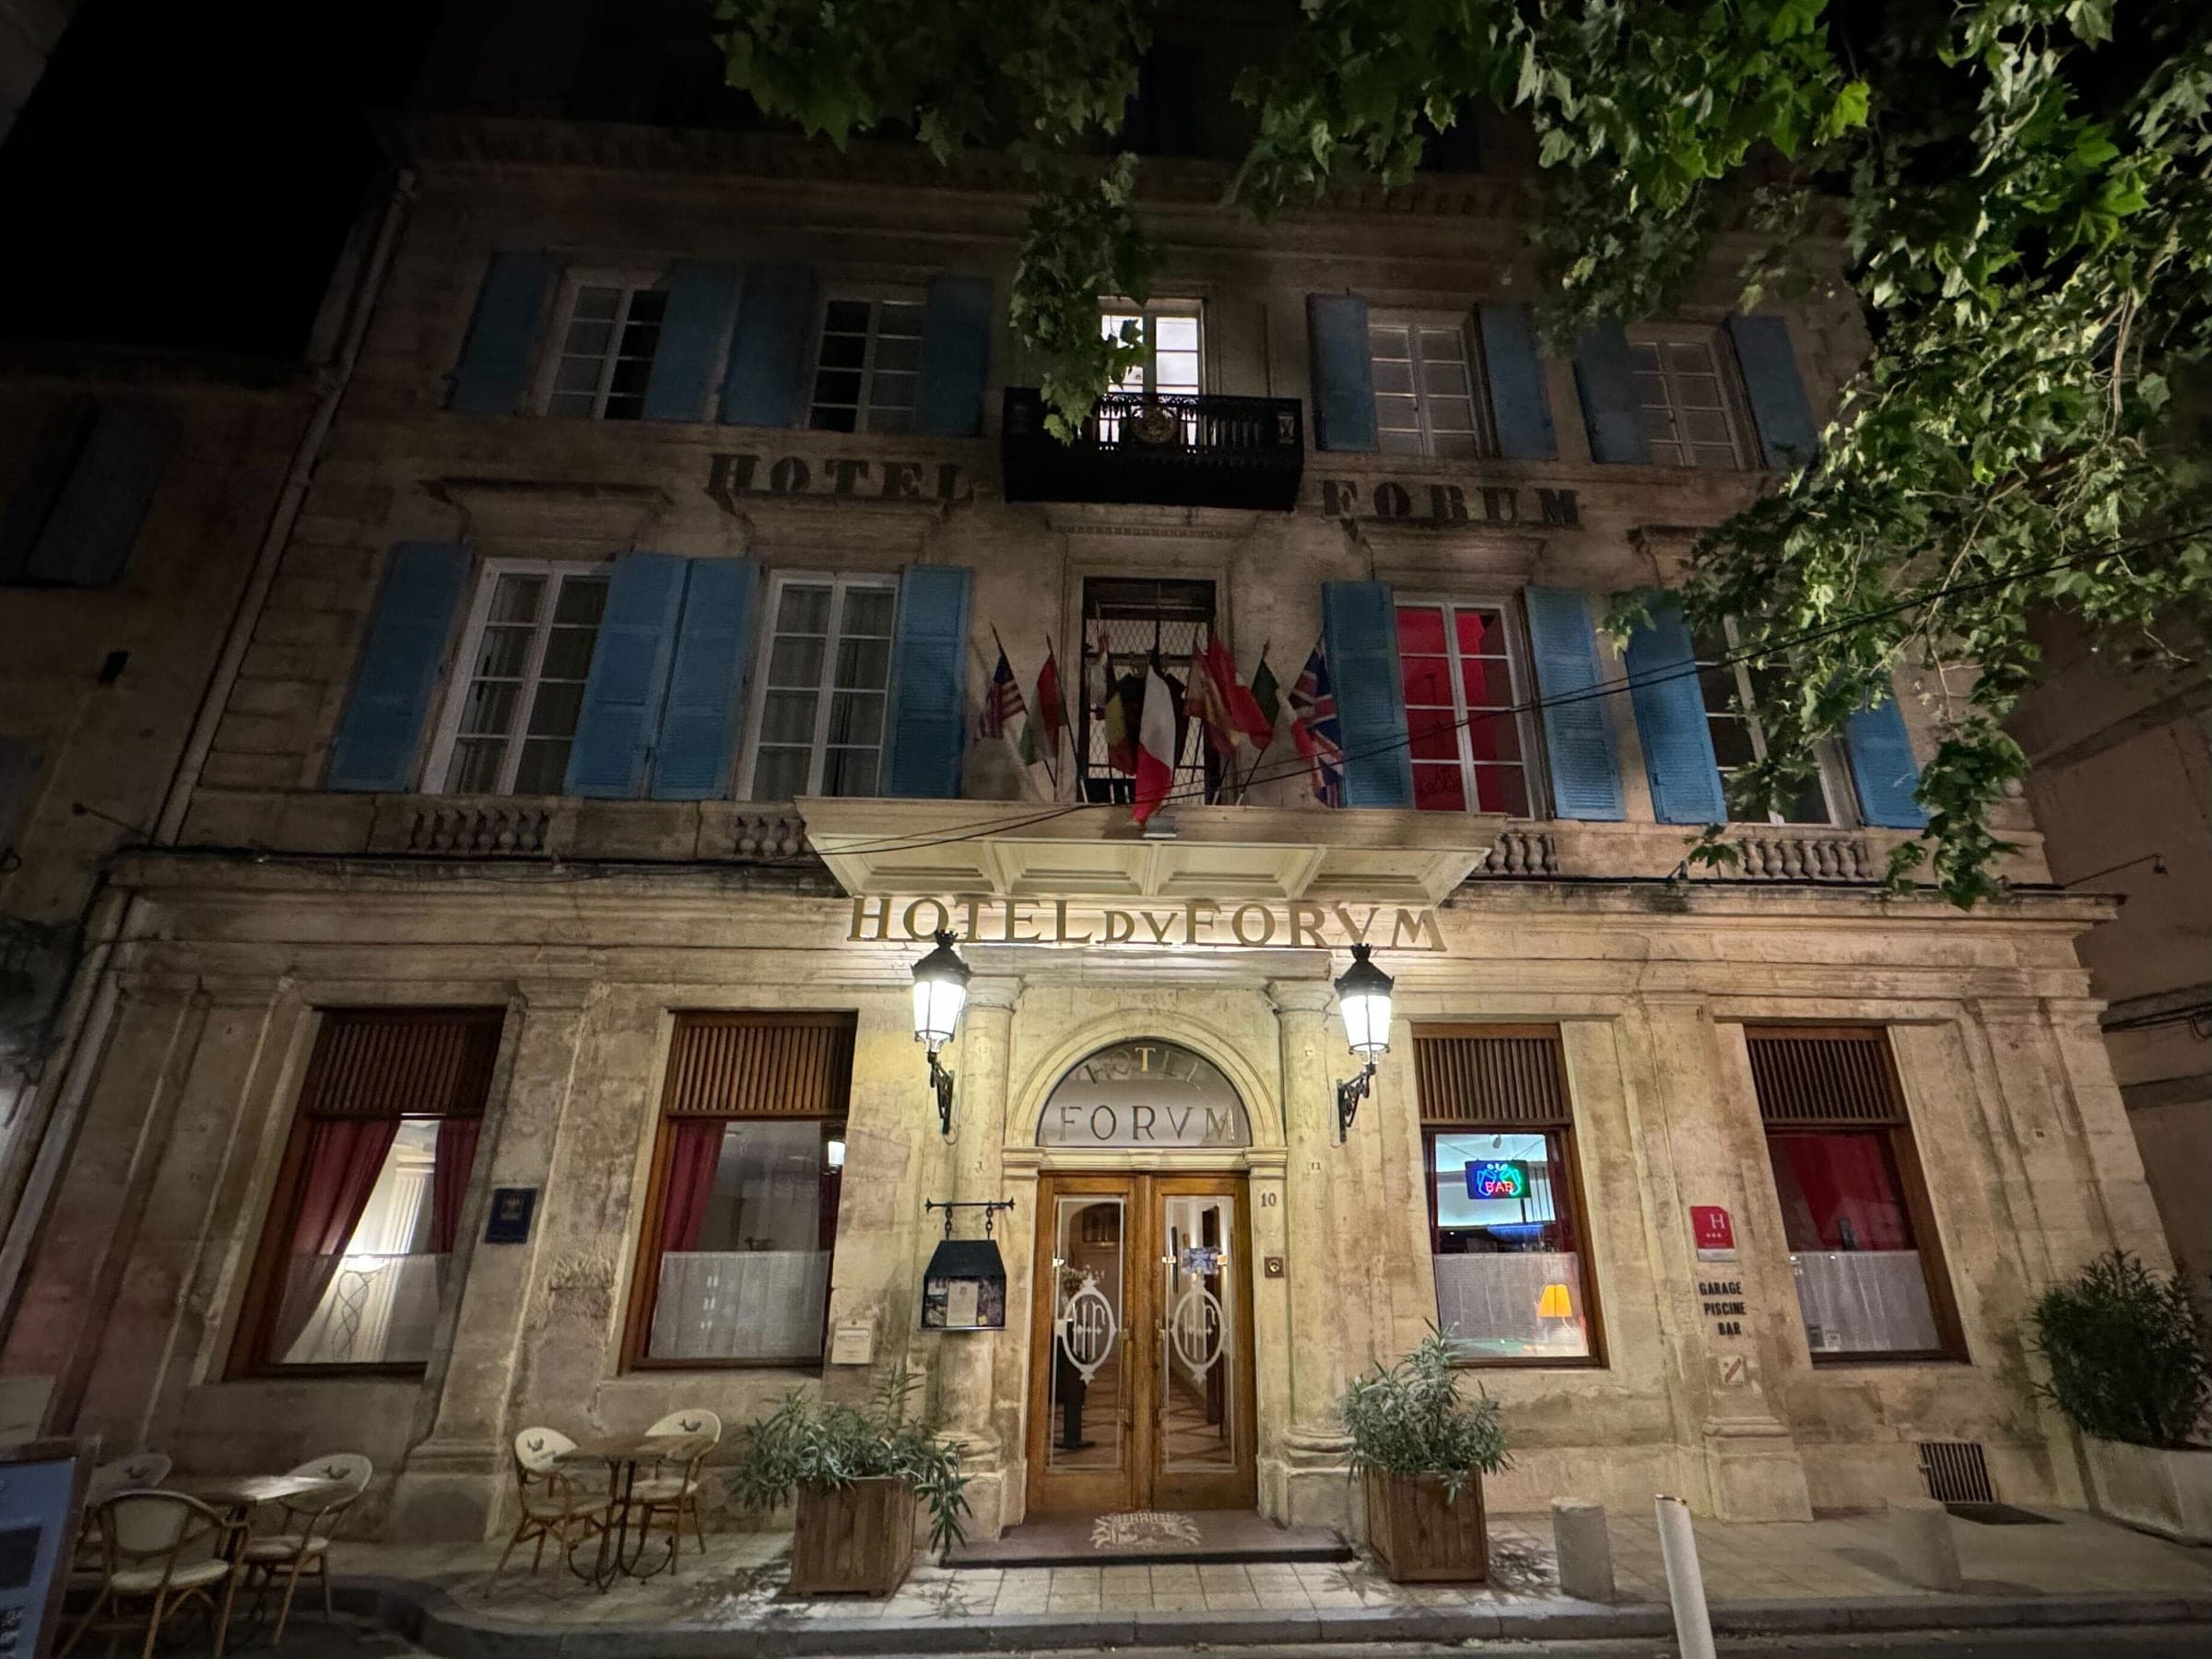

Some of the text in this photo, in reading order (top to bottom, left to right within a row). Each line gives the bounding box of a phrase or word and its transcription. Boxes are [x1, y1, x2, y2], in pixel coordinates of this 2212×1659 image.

[708, 453, 974, 503] HOTEL
[1321, 479, 1580, 526] FORUM
[846, 894, 1093, 944] HOTEL
[1083, 1046, 1202, 1091] HOTEL
[1484, 1180, 1514, 1194] BAR
[1261, 1193, 1277, 1207] 10
[1710, 1213, 1725, 1230] H
[1699, 1281, 1743, 1296] GARAGE
[1703, 1301, 1747, 1316] PISCINE
[1718, 1322, 1742, 1336] BAR
